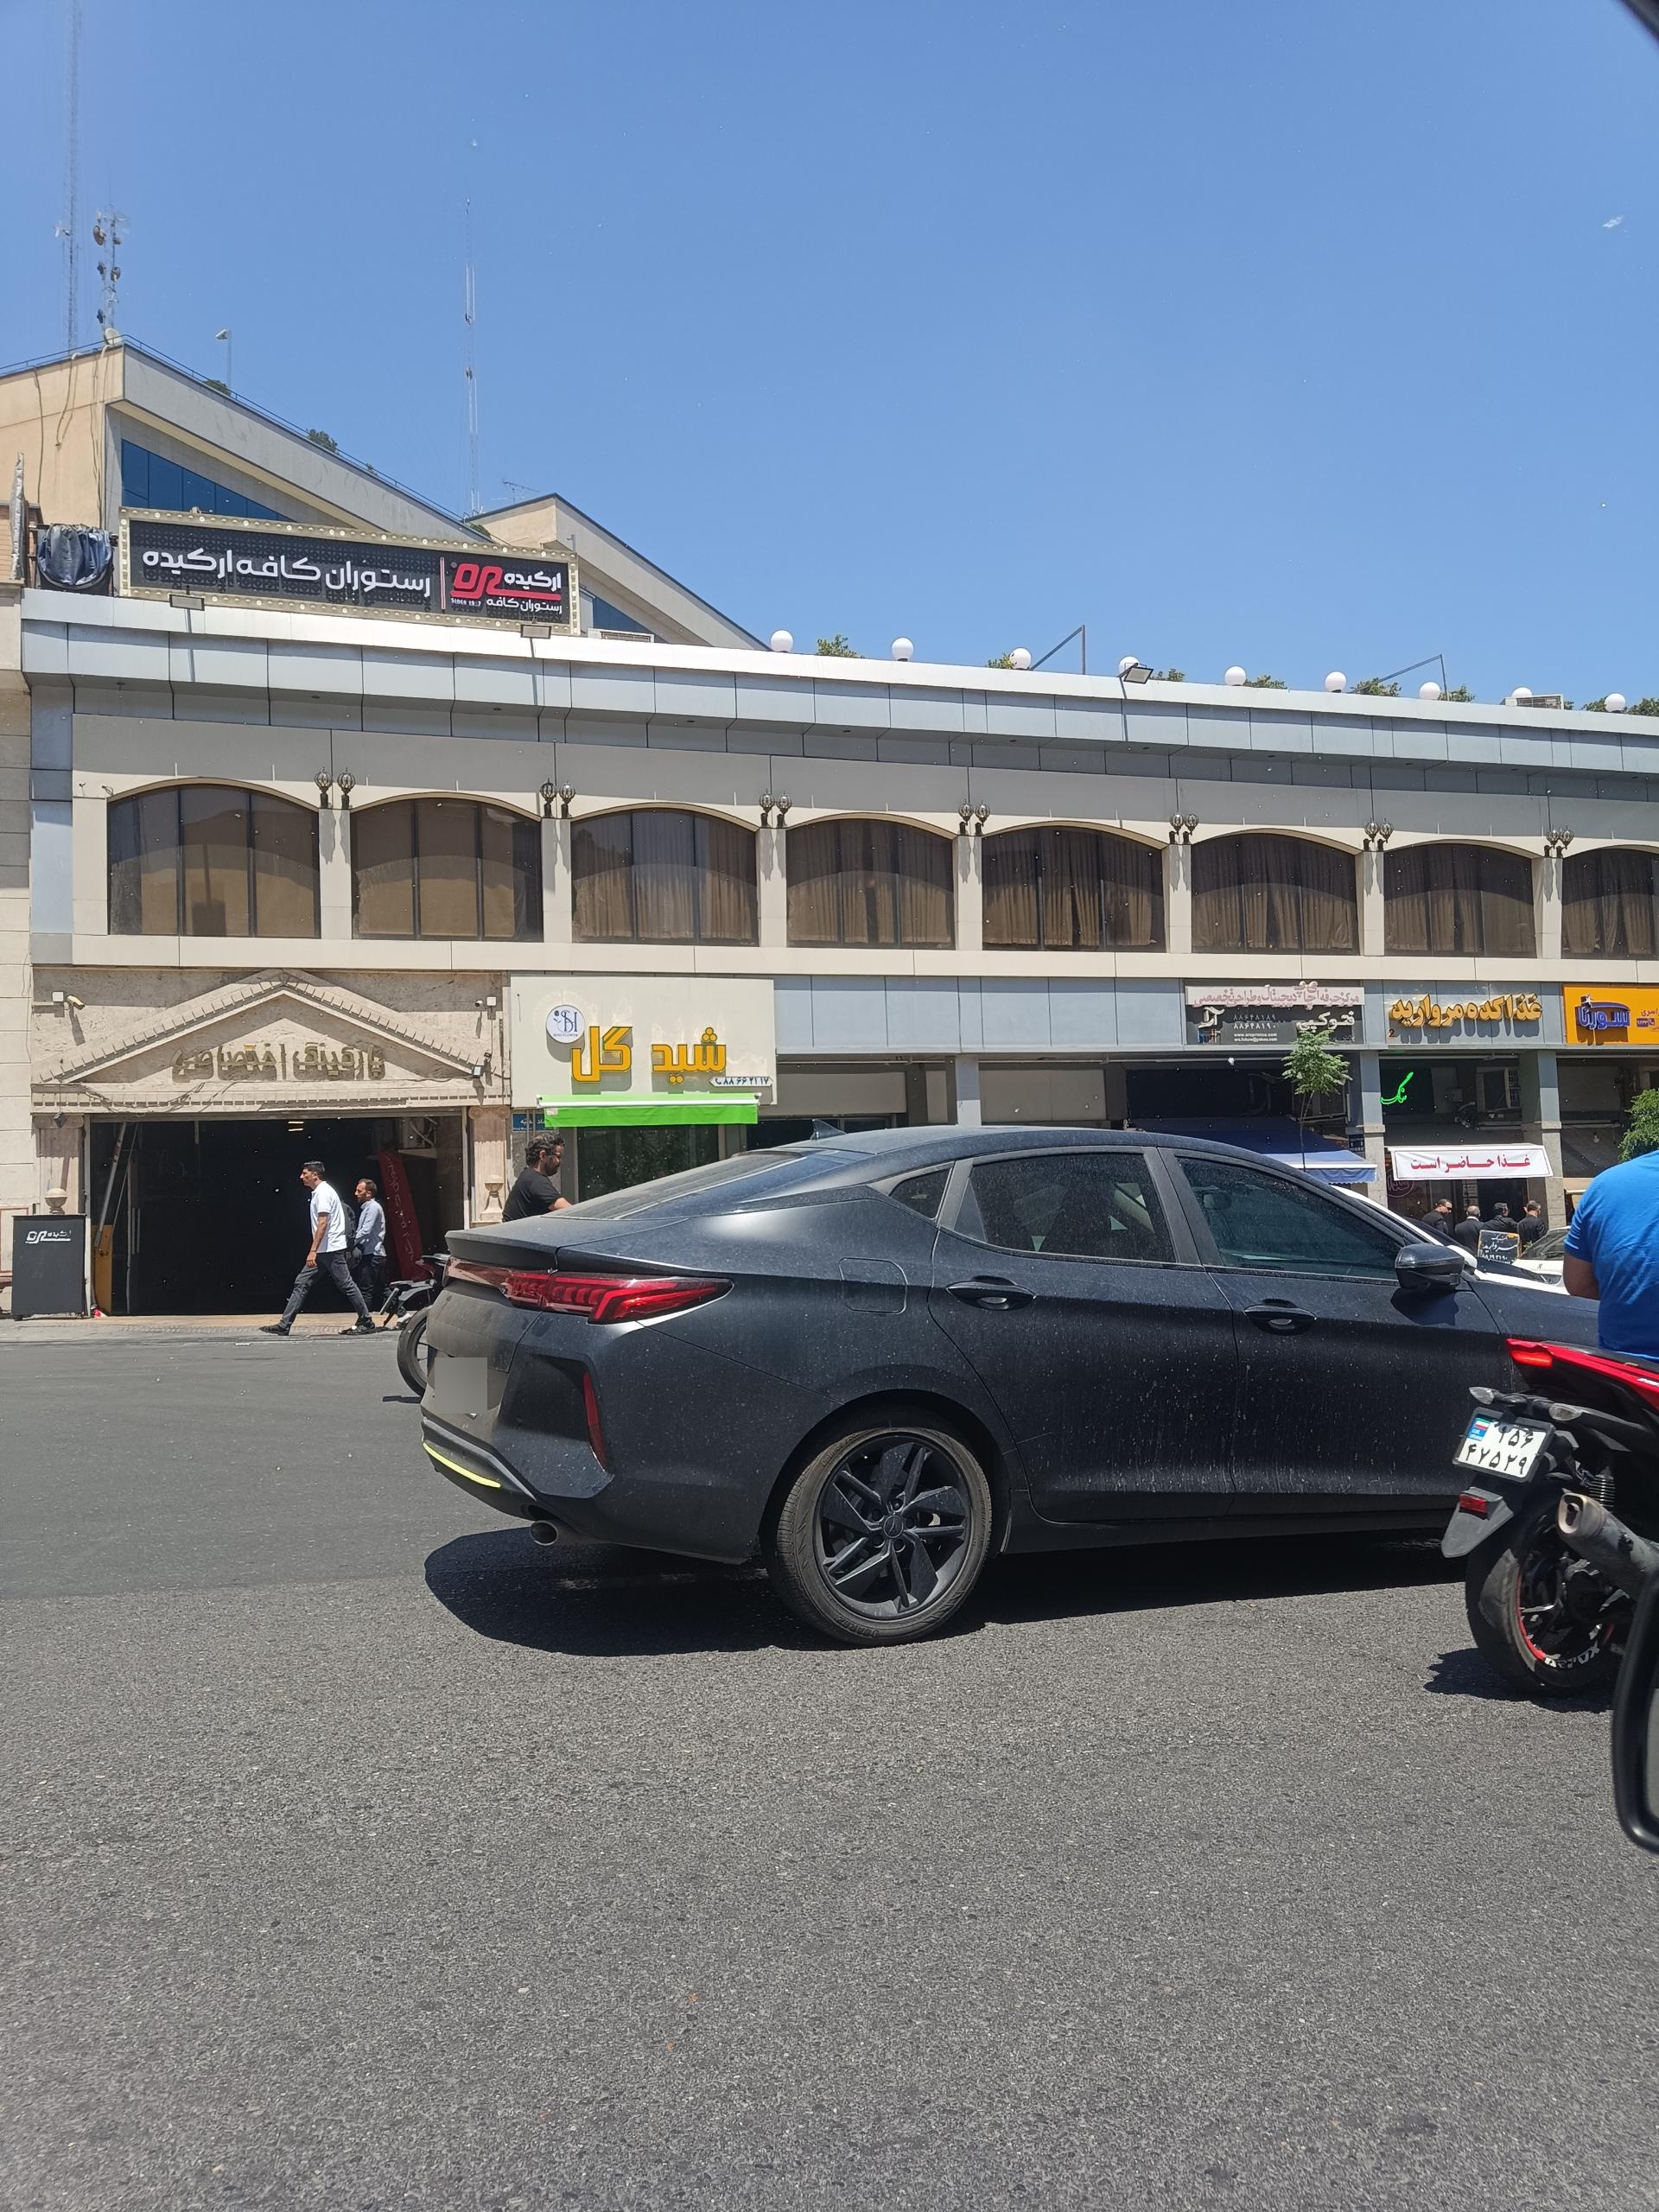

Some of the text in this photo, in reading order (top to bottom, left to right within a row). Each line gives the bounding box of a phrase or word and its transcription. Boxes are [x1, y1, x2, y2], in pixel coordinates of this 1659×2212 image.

[143, 548, 431, 598] رستوران کافه ارکیده
[504, 570, 562, 592] ارکیده
[486, 596, 563, 614] رستوران کافه
[1296, 1010, 1356, 1033] فتوکپی
[1390, 994, 1465, 1027] مروارید
[171, 1041, 385, 1077] پارکینگ اختصاصی
[571, 1026, 726, 1085] شید گل
[1410, 1154, 1530, 1173] غذا حاضر است
